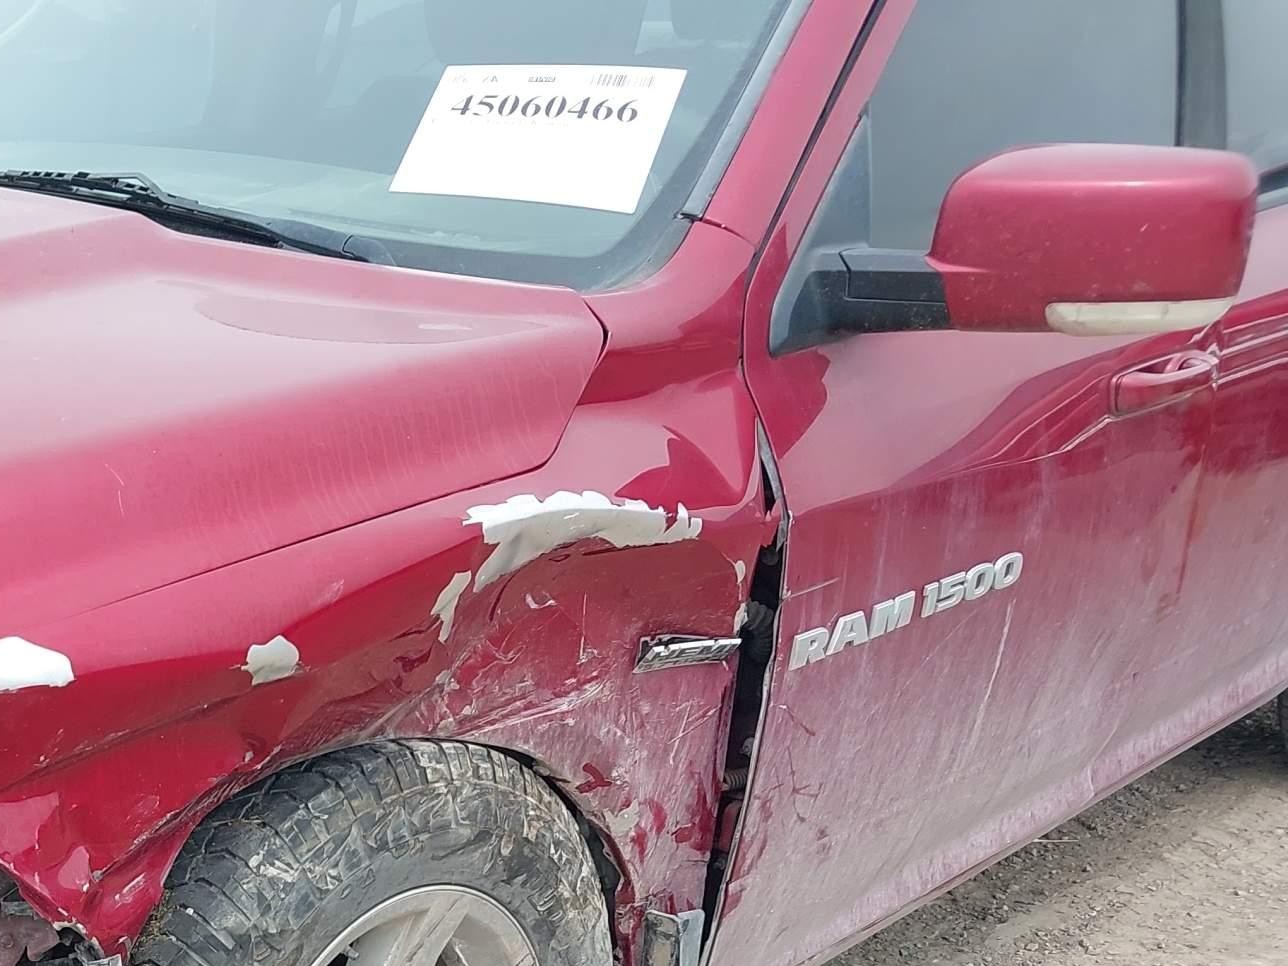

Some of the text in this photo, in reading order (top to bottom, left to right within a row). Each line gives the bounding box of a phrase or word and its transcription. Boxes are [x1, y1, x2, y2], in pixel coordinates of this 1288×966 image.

[449, 93, 640, 124] 45060466
[788, 551, 1025, 672] RAM 1500
